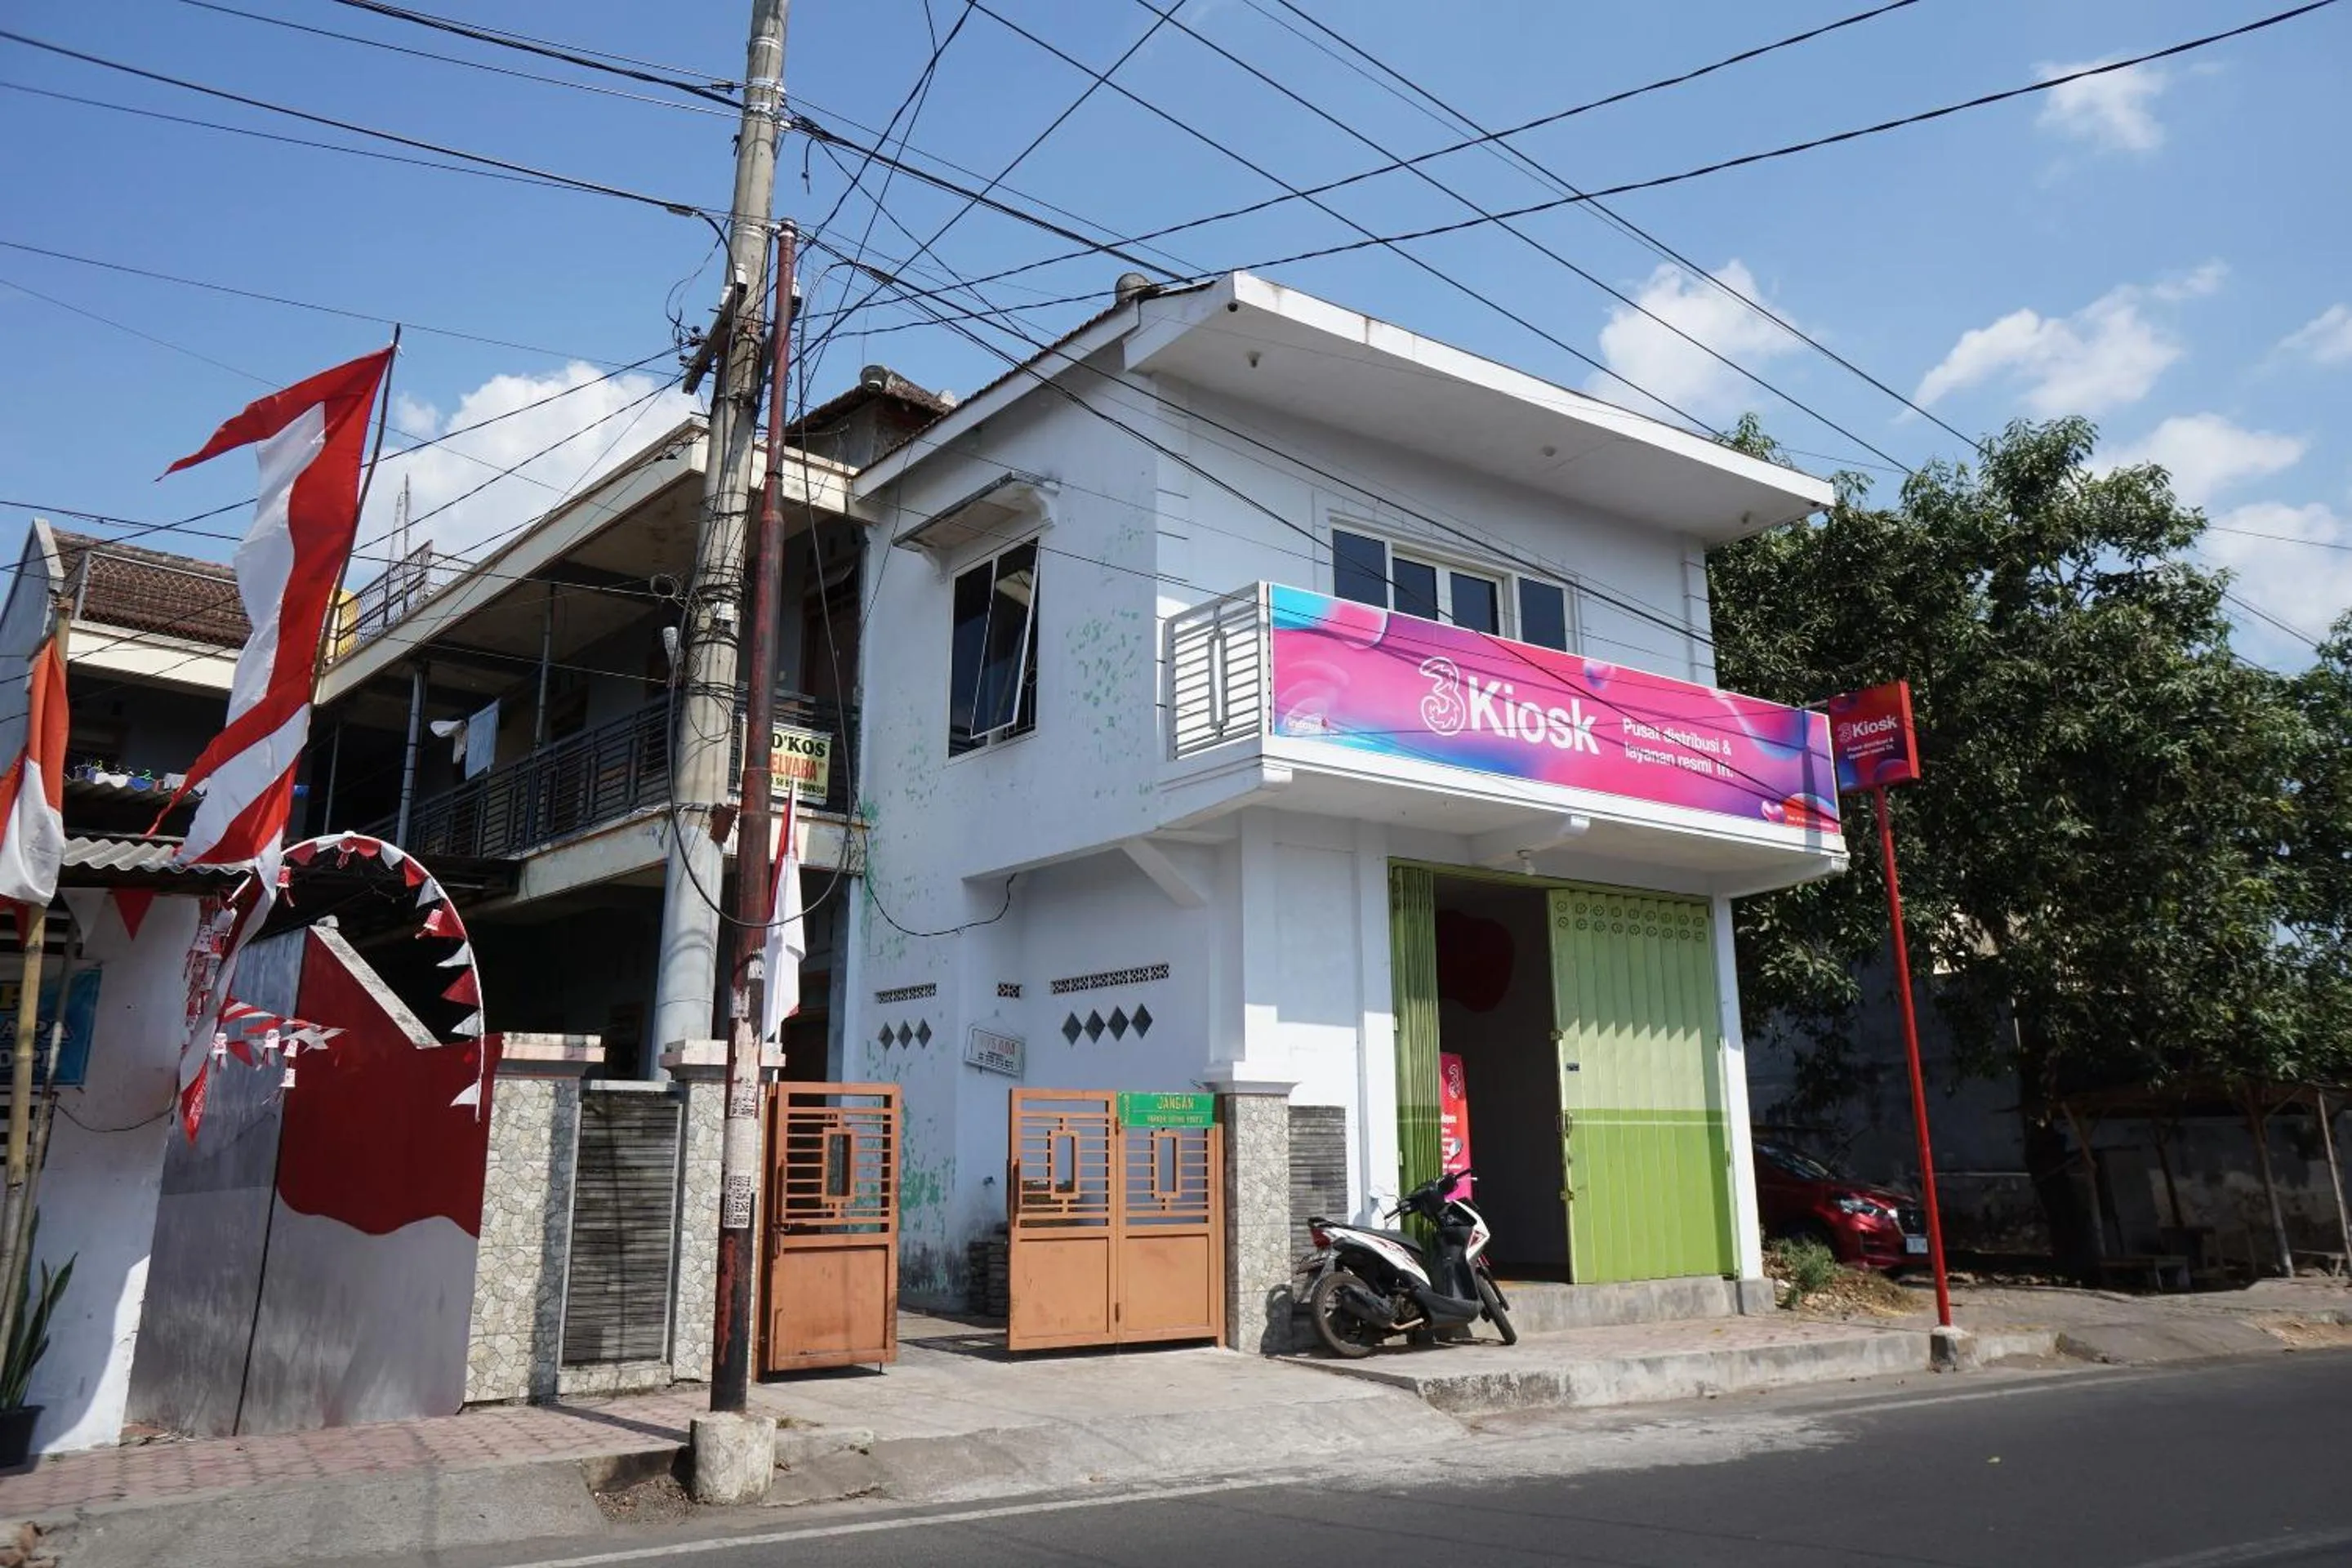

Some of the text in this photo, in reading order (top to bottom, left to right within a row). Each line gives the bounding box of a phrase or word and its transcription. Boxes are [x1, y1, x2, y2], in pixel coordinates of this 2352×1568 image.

[1468, 676, 1600, 755] Kiosk
[1852, 715, 1898, 738] Kiosk
[1623, 717, 1732, 756] Pusat distribusi &
[1625, 741, 1675, 766] layanan
[1677, 754, 1713, 774] resmi
[1156, 1095, 1195, 1111] JANGAN
